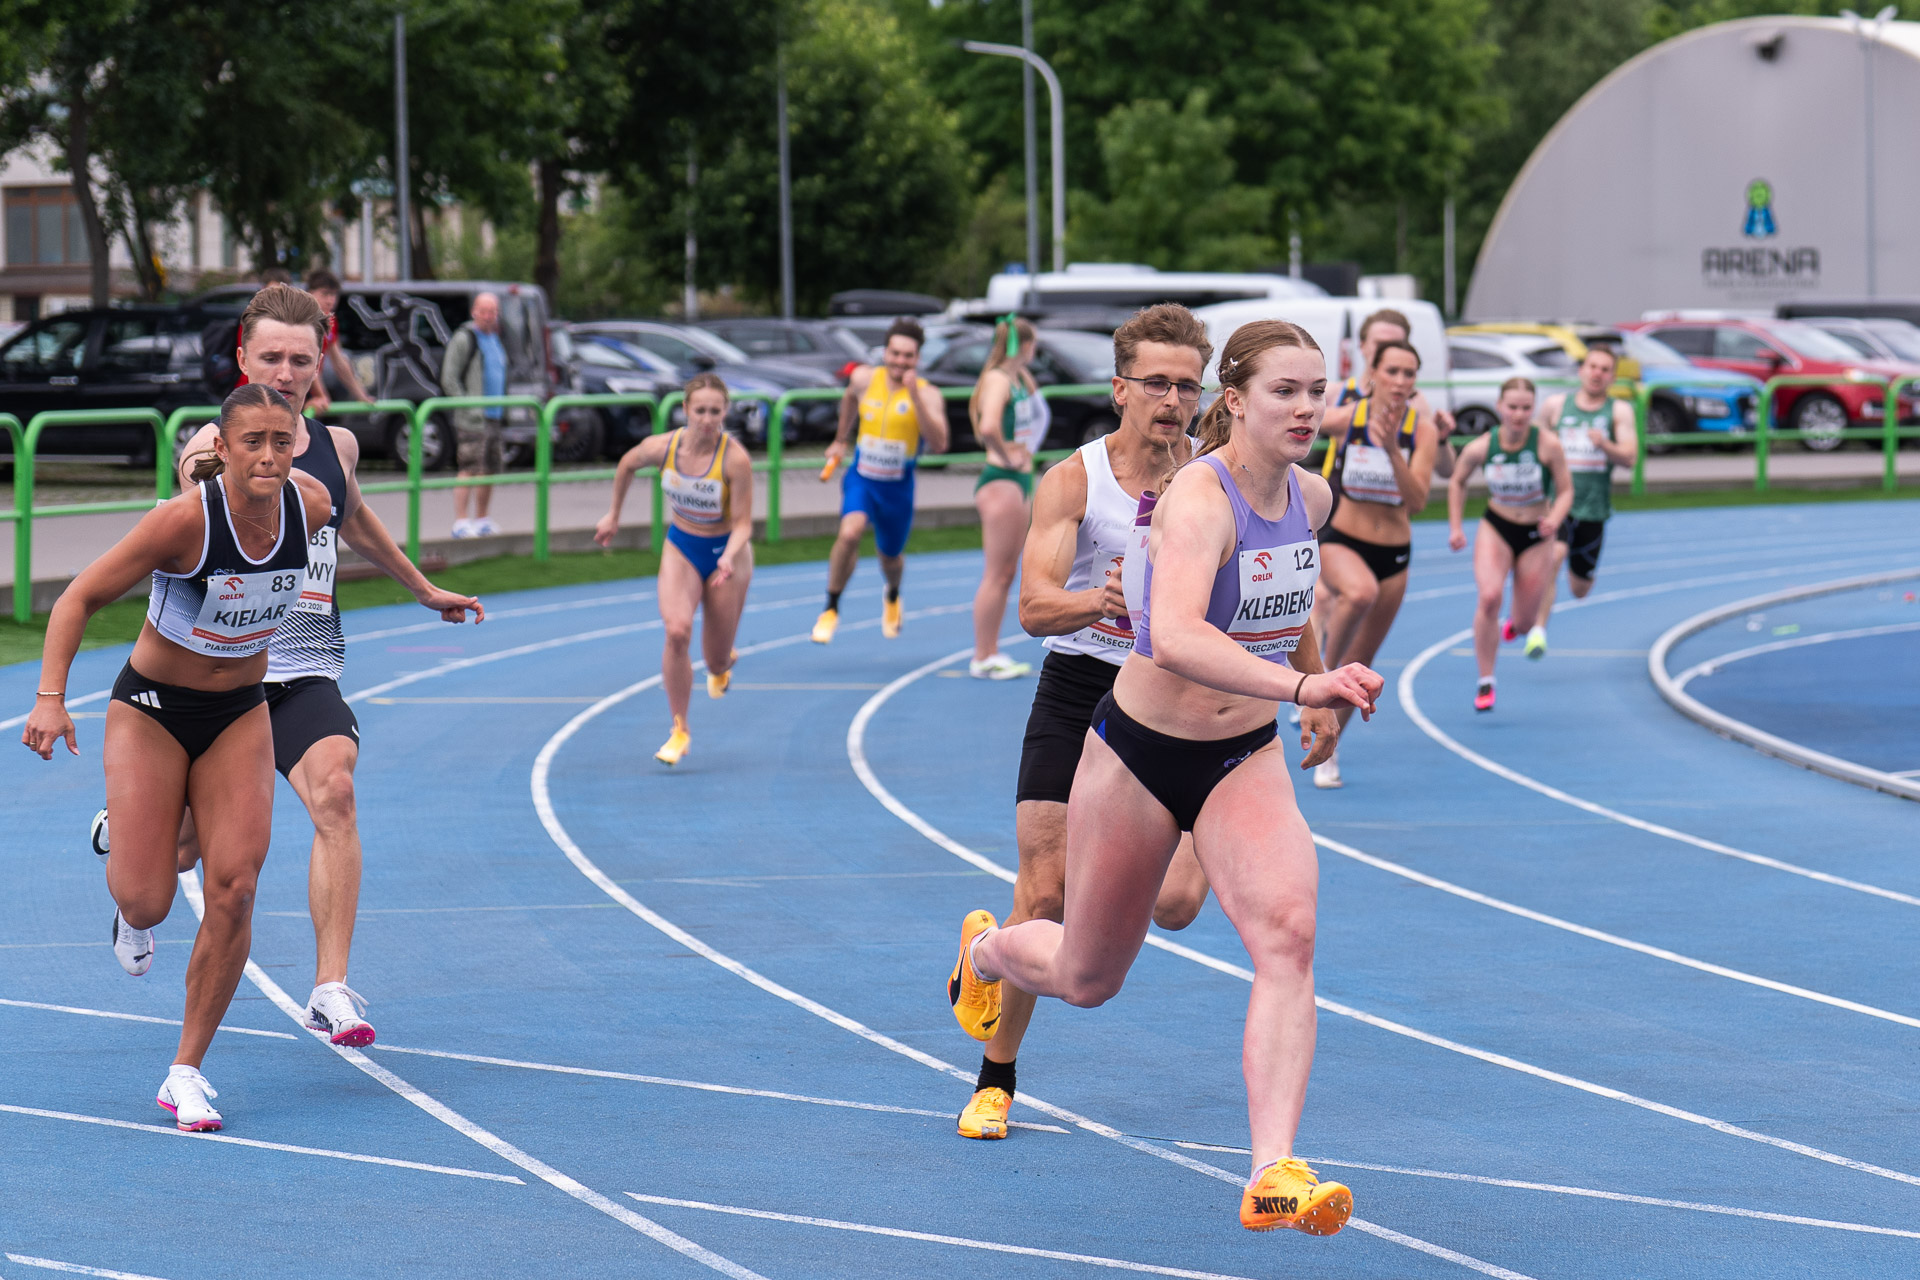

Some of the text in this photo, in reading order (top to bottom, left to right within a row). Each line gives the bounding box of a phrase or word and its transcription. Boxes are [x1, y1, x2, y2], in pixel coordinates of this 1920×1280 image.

[1702, 246, 1820, 276] ARENA
[693, 482, 715, 494] 426
[1294, 548, 1314, 571] 12
[271, 574, 296, 593] 83
[1252, 572, 1273, 583] ORLEN
[219, 593, 245, 601] ORLEN
[213, 604, 287, 628] KIELAR
[204, 641, 257, 652] PIASECZNO
[1251, 1195, 1298, 1214] NITRO
